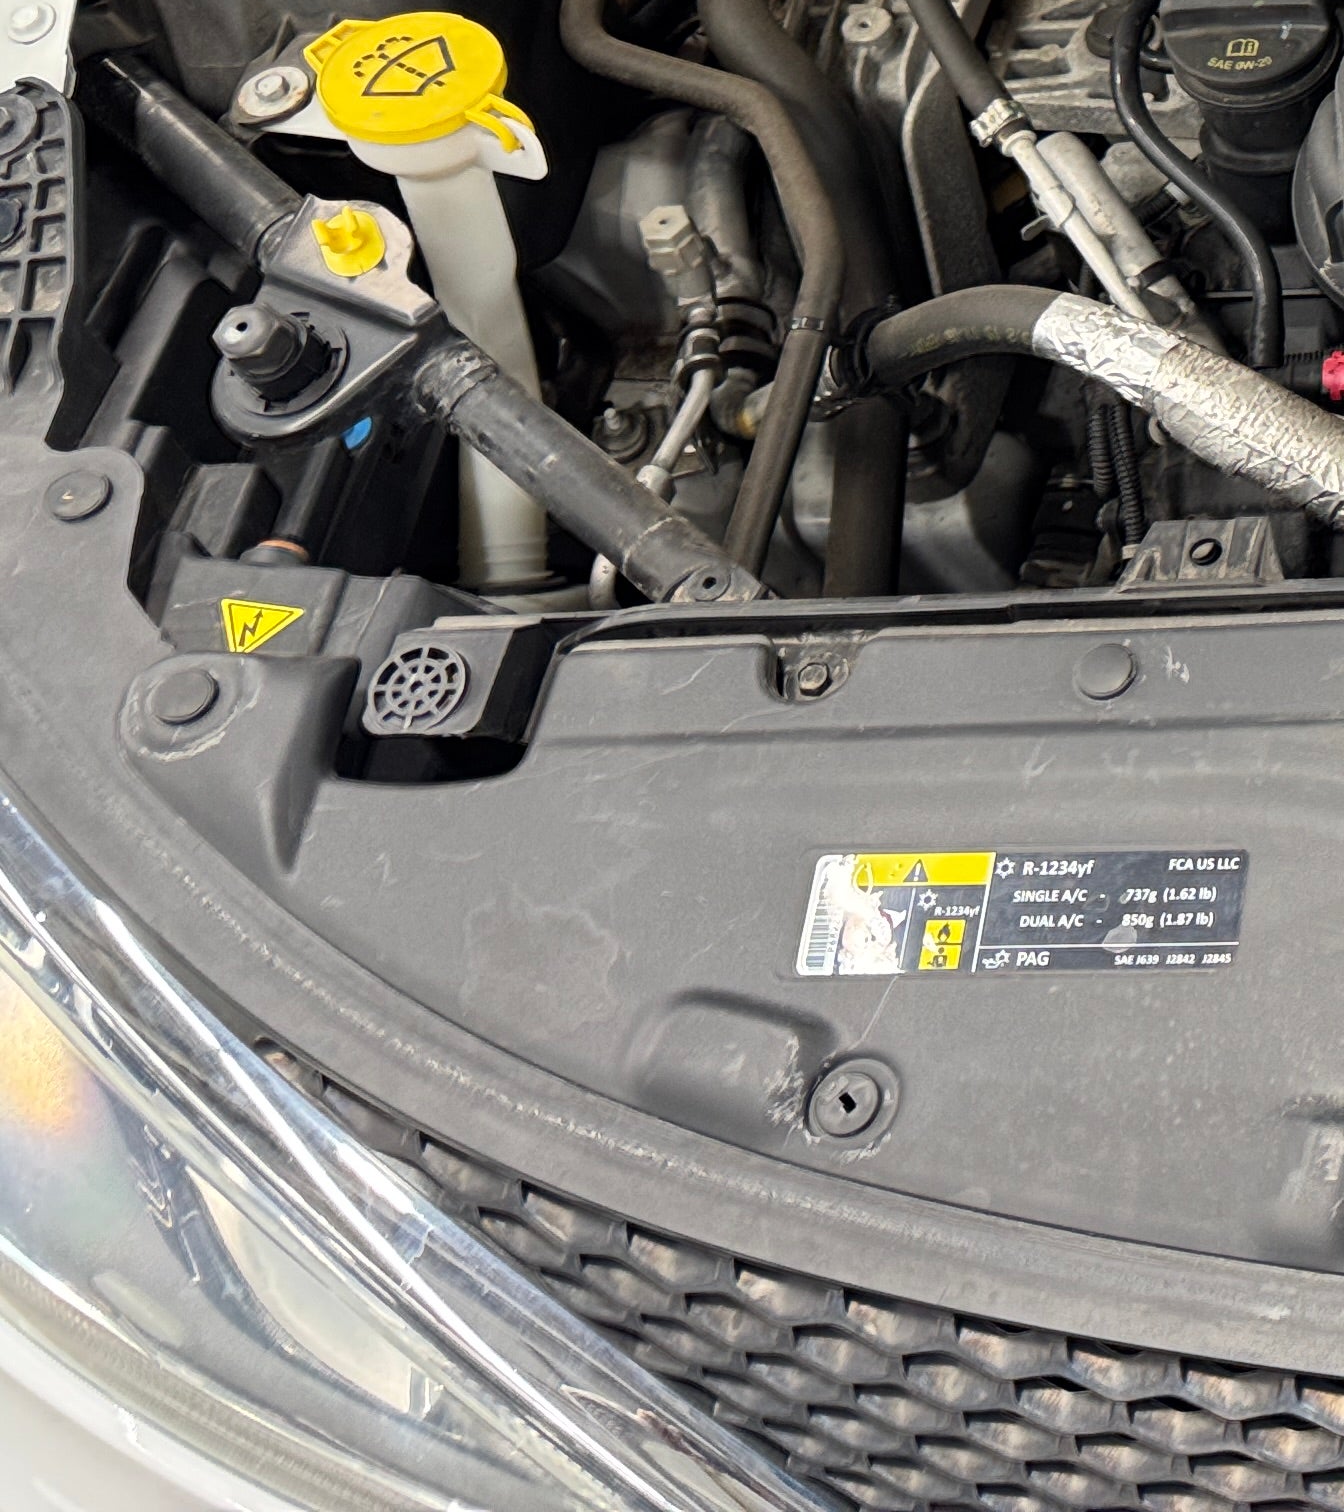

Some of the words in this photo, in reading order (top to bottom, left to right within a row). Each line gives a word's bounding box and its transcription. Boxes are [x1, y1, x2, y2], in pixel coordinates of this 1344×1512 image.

[1207, 57, 1233, 70] SAE
[1234, 56, 1273, 70] 0W-20
[1022, 860, 1096, 879] R-1234yf
[1168, 858, 1194, 871] FCA
[1196, 858, 1215, 871] US
[1216, 857, 1240, 870] LLC
[1012, 889, 1060, 903] SINGLE
[1060, 889, 1089, 904] A/C
[1125, 888, 1158, 903] 737g
[1162, 887, 1197, 902] (1.62
[1198, 886, 1217, 902] lb)
[934, 905, 980, 918] R-1234yf
[1019, 915, 1056, 928] DUAL
[1056, 914, 1085, 929] A/C
[1121, 913, 1154, 928] 850g
[1159, 912, 1194, 928] (1.87
[1195, 911, 1214, 927] lb)
[1016, 951, 1050, 967] PAG
[1114, 954, 1134, 966] SAE
[1135, 954, 1160, 966] J639
